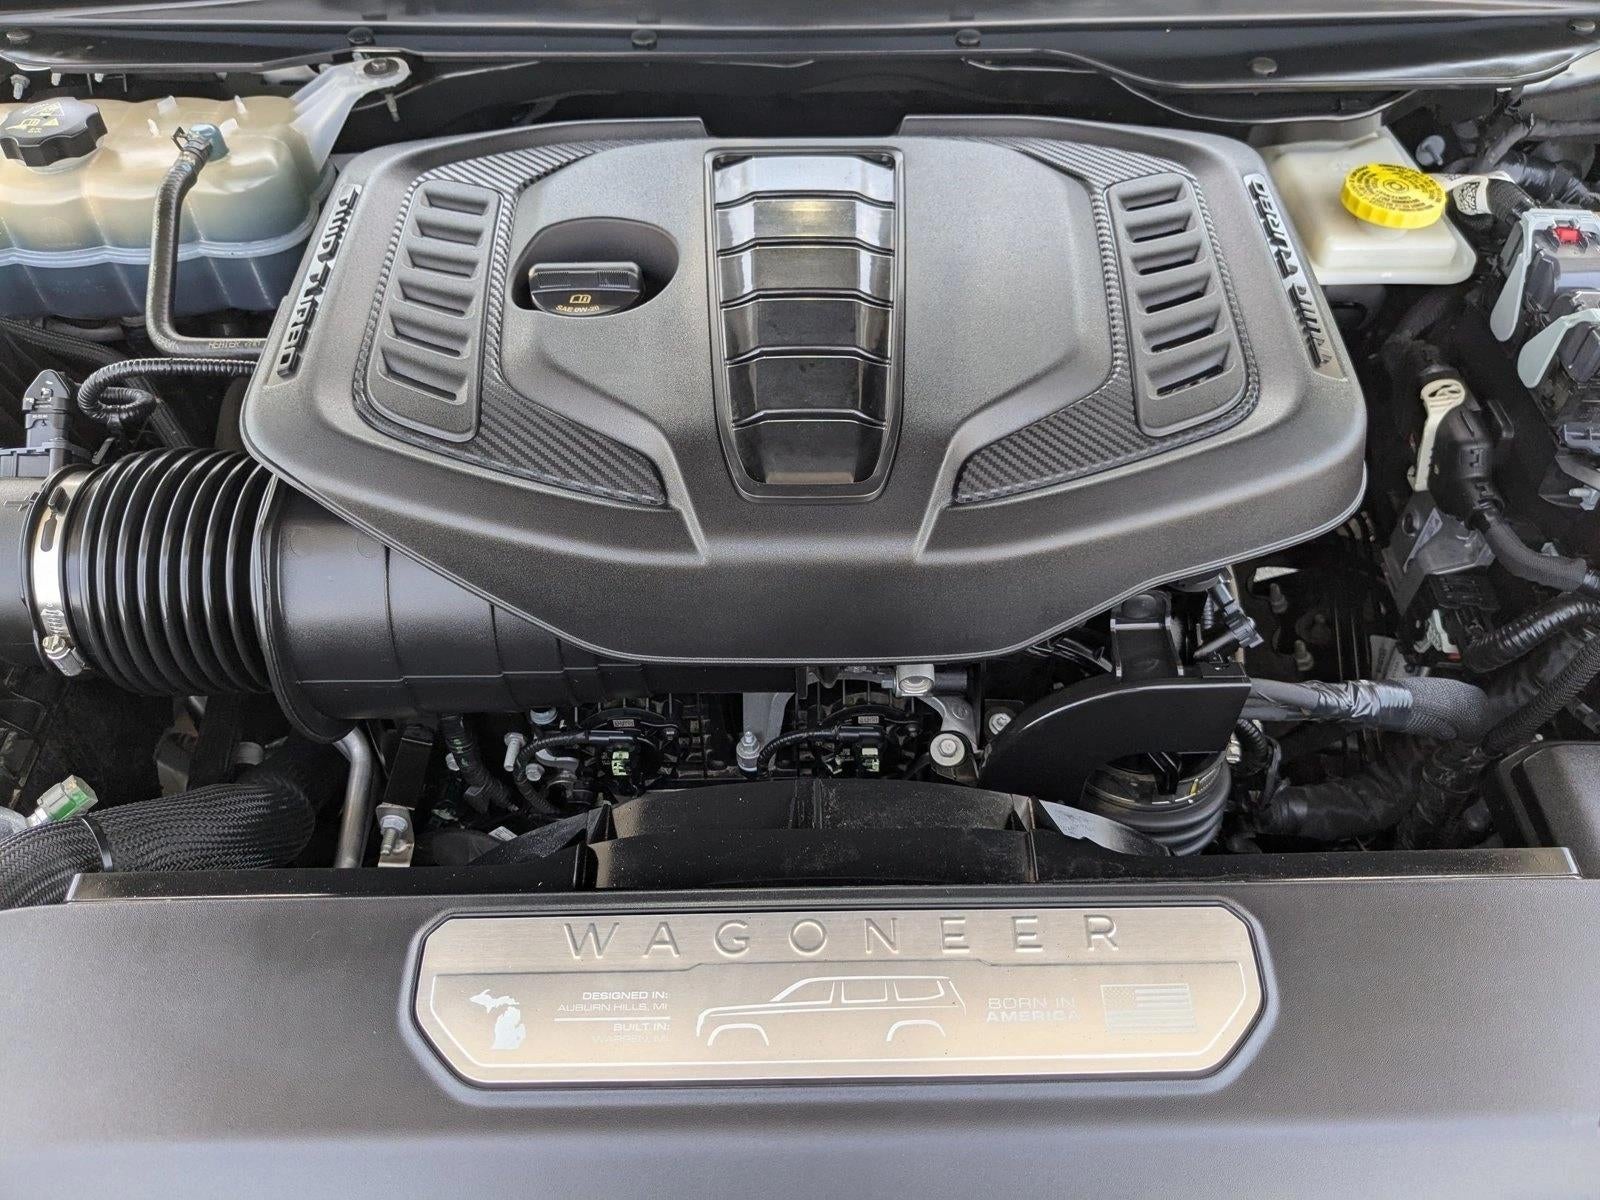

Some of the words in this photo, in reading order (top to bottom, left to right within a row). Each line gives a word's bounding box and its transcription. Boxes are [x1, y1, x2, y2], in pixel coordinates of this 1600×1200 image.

[1249, 180, 1299, 280] TURBO
[556, 304, 573, 313] SAE
[276, 261, 332, 378] TURBO
[563, 914, 1120, 960] WAGONEER
[582, 991, 649, 1001] DESIGNED
[651, 991, 669, 1000] IN:
[988, 997, 1048, 1009] BORN
[1056, 996, 1077, 1009] IN
[558, 1003, 611, 1013] AUBURN
[613, 1002, 650, 1012] HILLS,
[652, 1002, 668, 1011] MI
[986, 1010, 1081, 1023] AMERICA
[613, 1022, 650, 1032] BUILT
[653, 1021, 670, 1031] IN:
